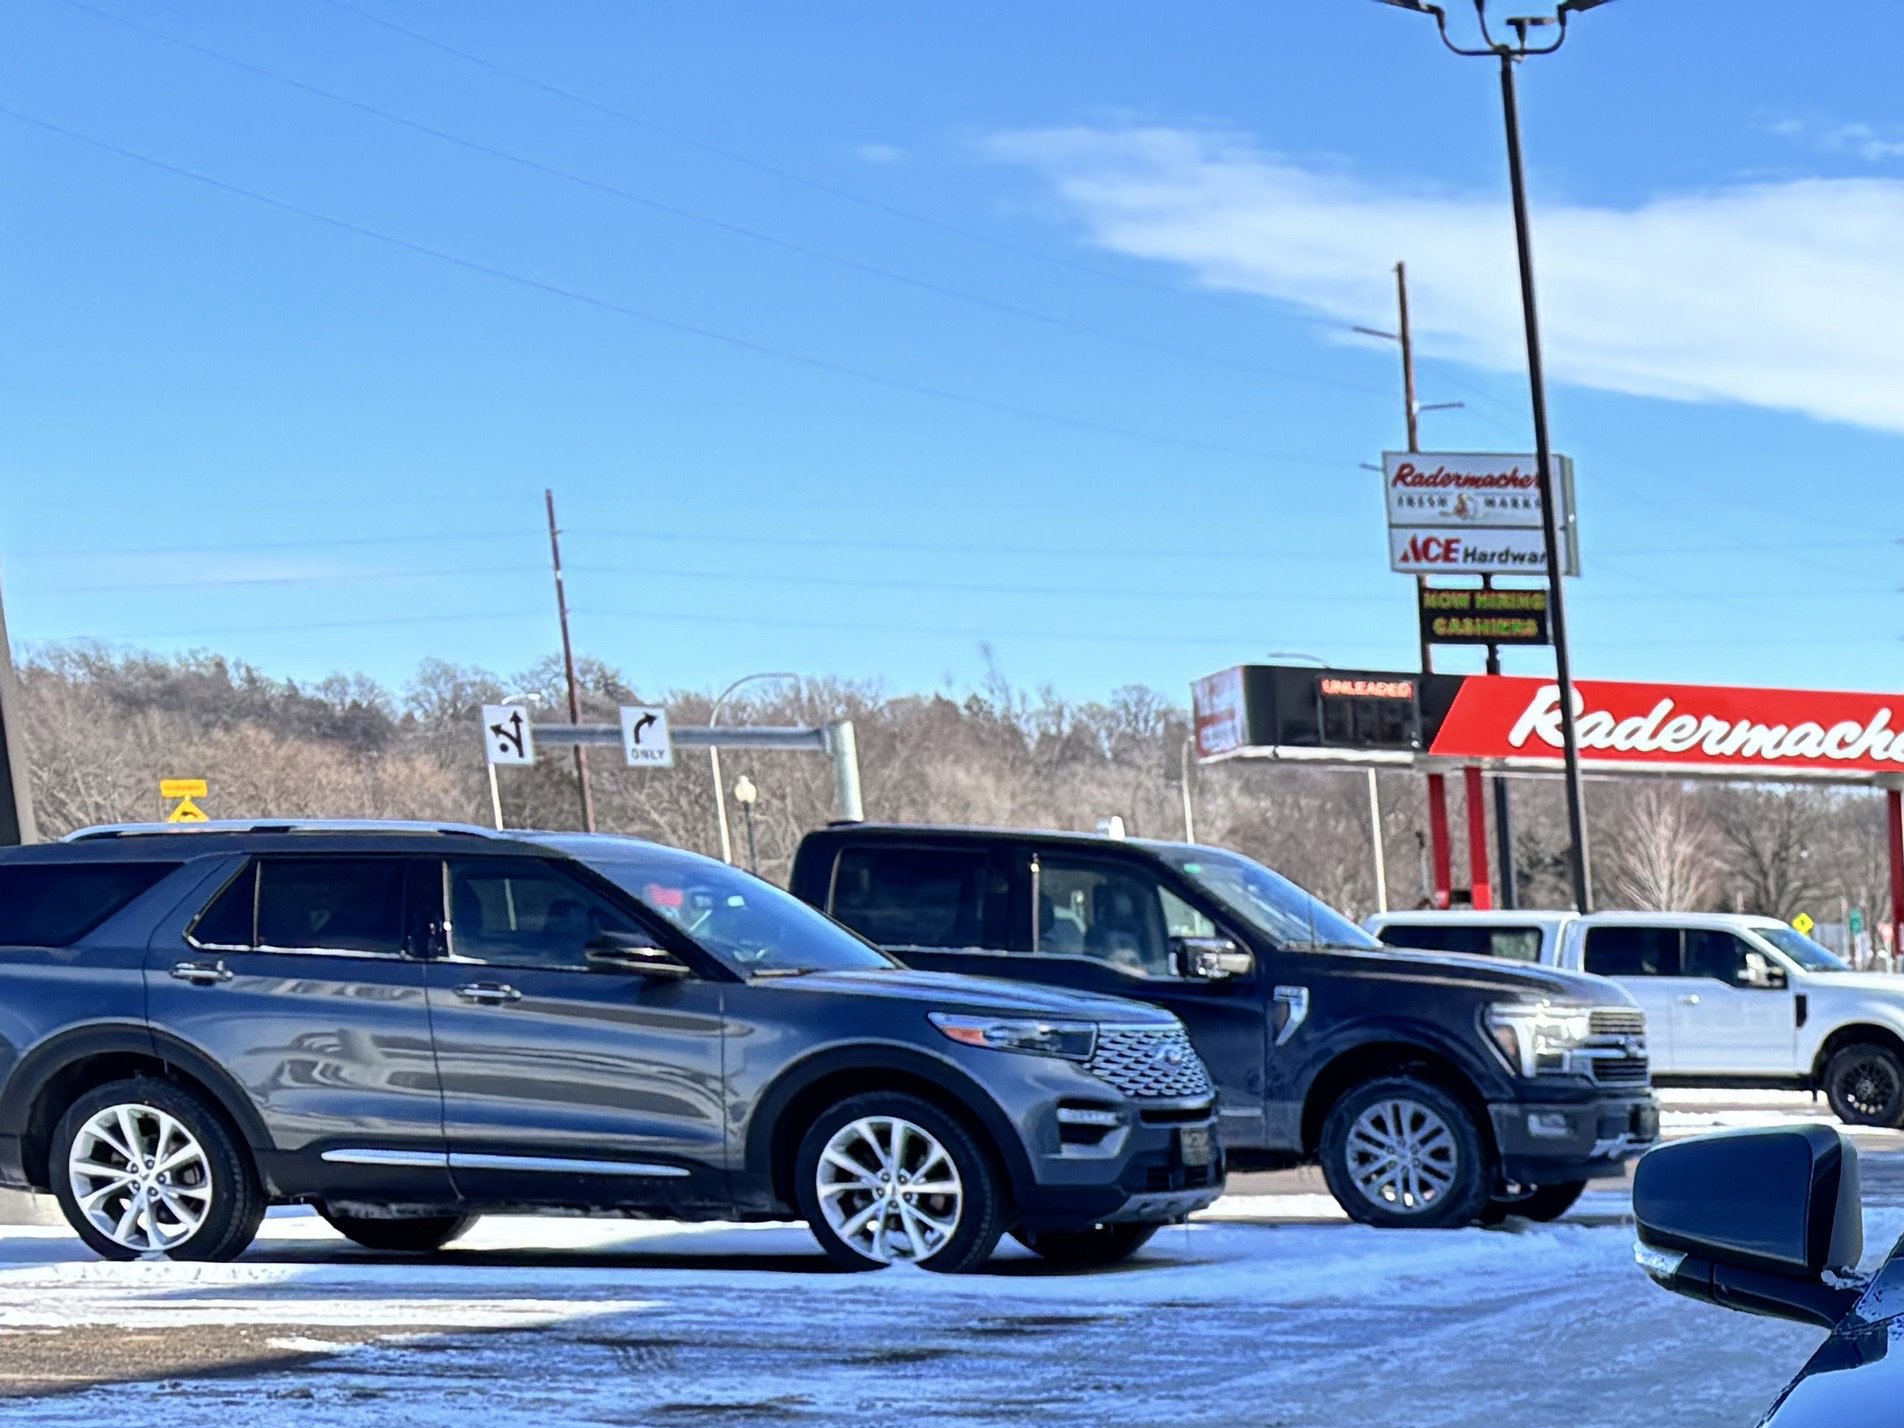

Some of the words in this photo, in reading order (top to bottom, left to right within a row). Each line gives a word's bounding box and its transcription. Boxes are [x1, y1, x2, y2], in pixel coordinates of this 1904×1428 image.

[1399, 533, 1461, 563] ACE
[1462, 545, 1546, 563] Hardwar
[1321, 678, 1413, 699] UNLEADED
[631, 748, 665, 760] ONLY
